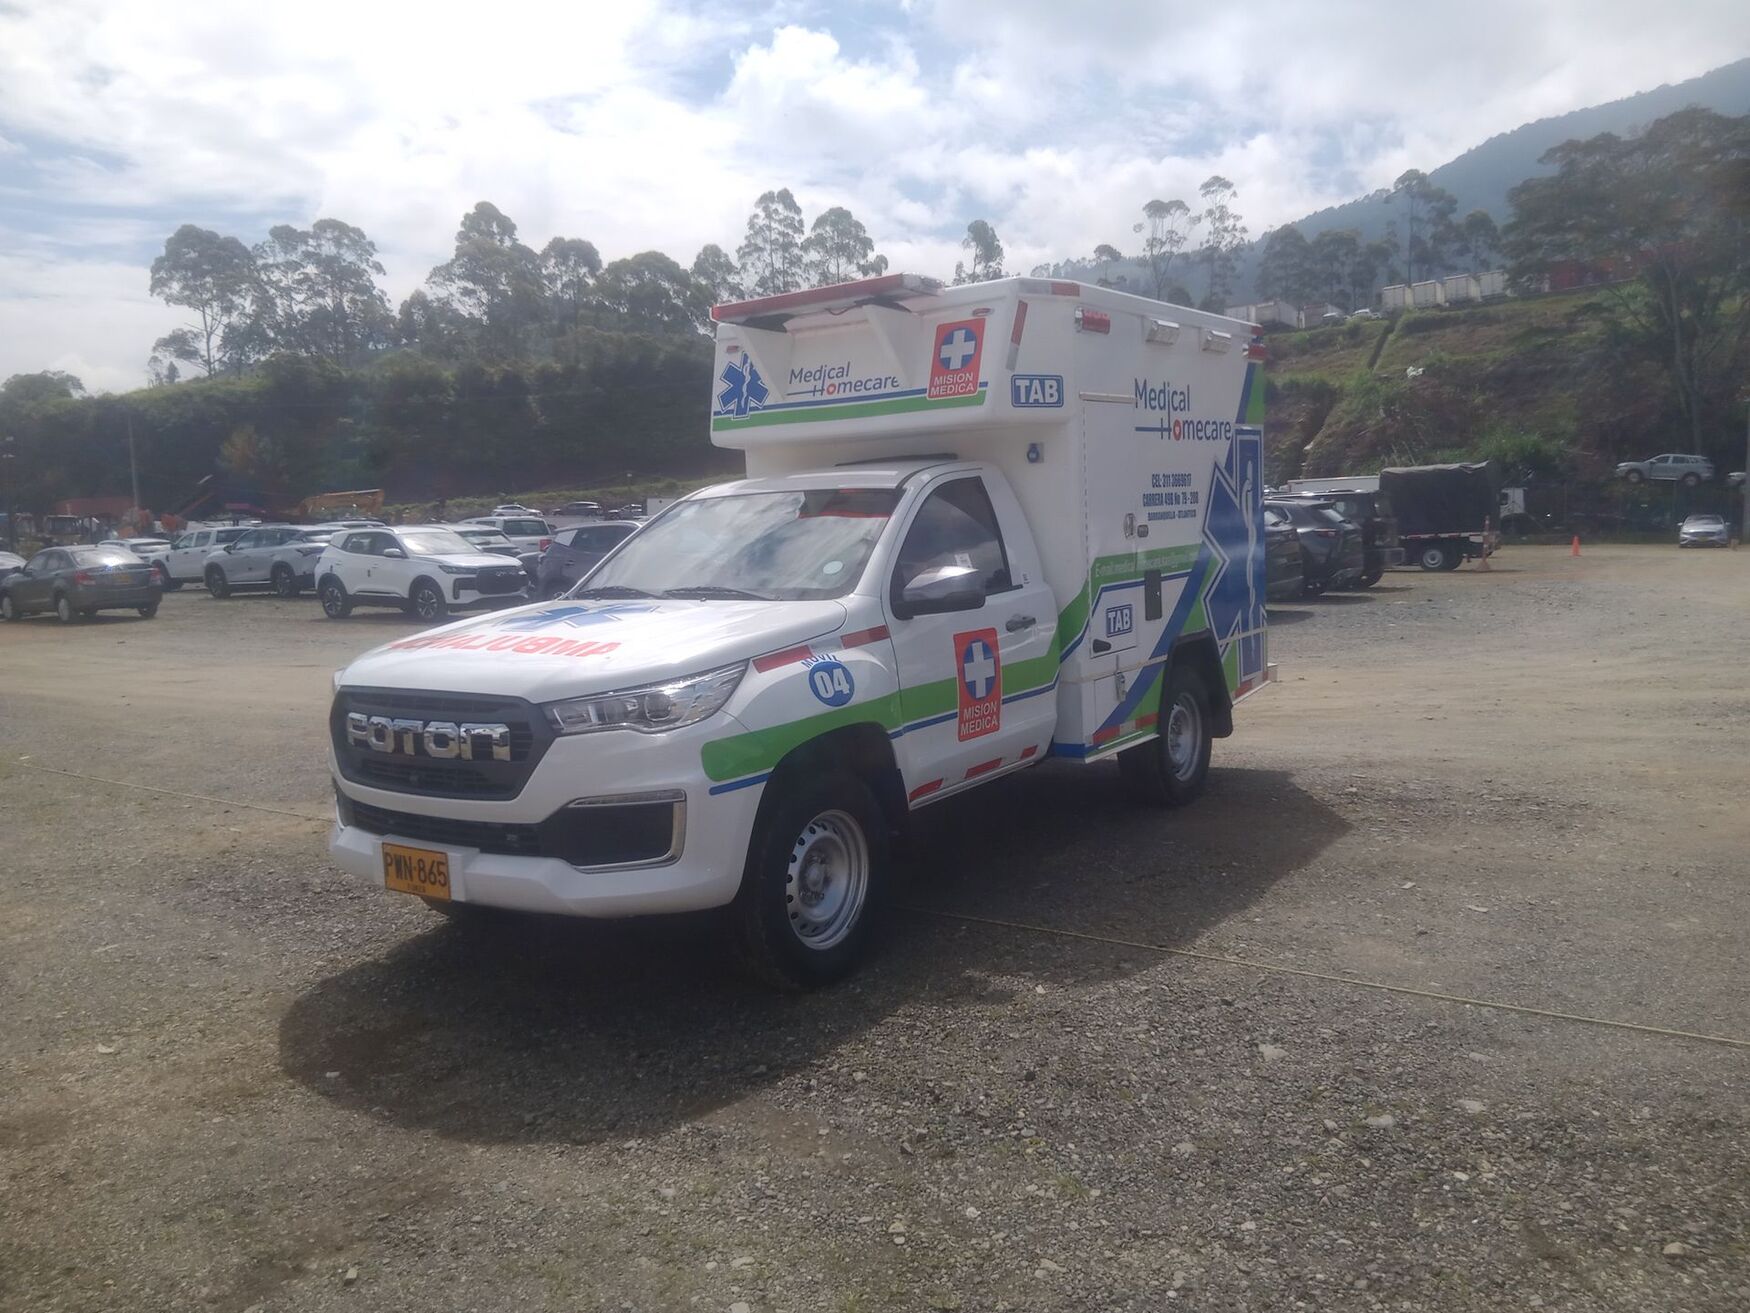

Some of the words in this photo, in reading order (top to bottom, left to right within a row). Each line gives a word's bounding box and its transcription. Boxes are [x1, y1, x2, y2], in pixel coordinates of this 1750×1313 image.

[788, 361, 851, 386] Medical
[933, 371, 974, 387] MISION
[812, 375, 900, 397] Homecare
[930, 381, 975, 396] MEDICA
[1014, 378, 1060, 405] TAB
[1134, 377, 1191, 412] Medical
[1160, 418, 1232, 442] Homecare
[1107, 606, 1132, 633] TAB
[813, 667, 850, 699] 04
[962, 701, 998, 721] MISION
[346, 711, 511, 762] FOTON
[960, 715, 999, 736] MEDICA
